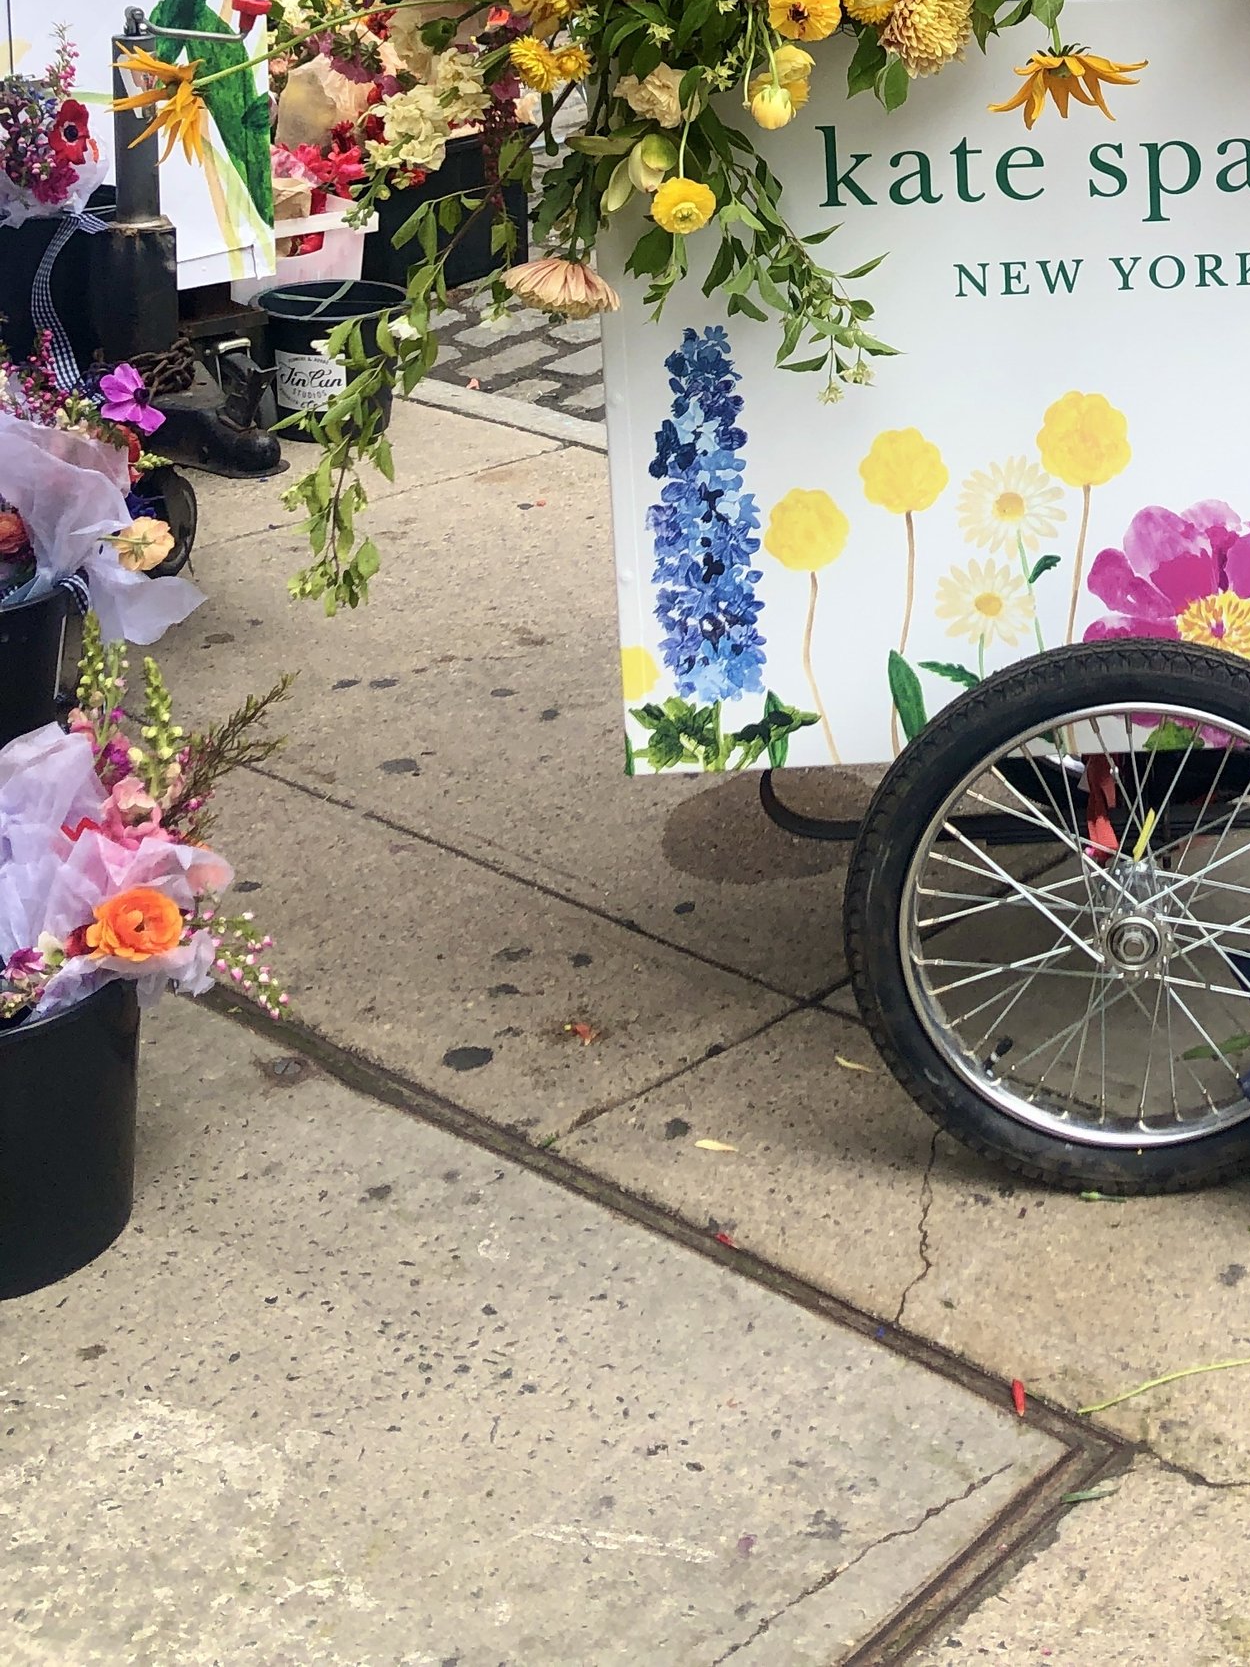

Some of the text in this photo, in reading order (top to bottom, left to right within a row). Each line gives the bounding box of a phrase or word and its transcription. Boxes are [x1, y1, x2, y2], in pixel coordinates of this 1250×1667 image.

[815, 125, 1045, 208] kate
[953, 258, 1083, 297] NEW
[292, 388, 327, 399] STUDIOS
